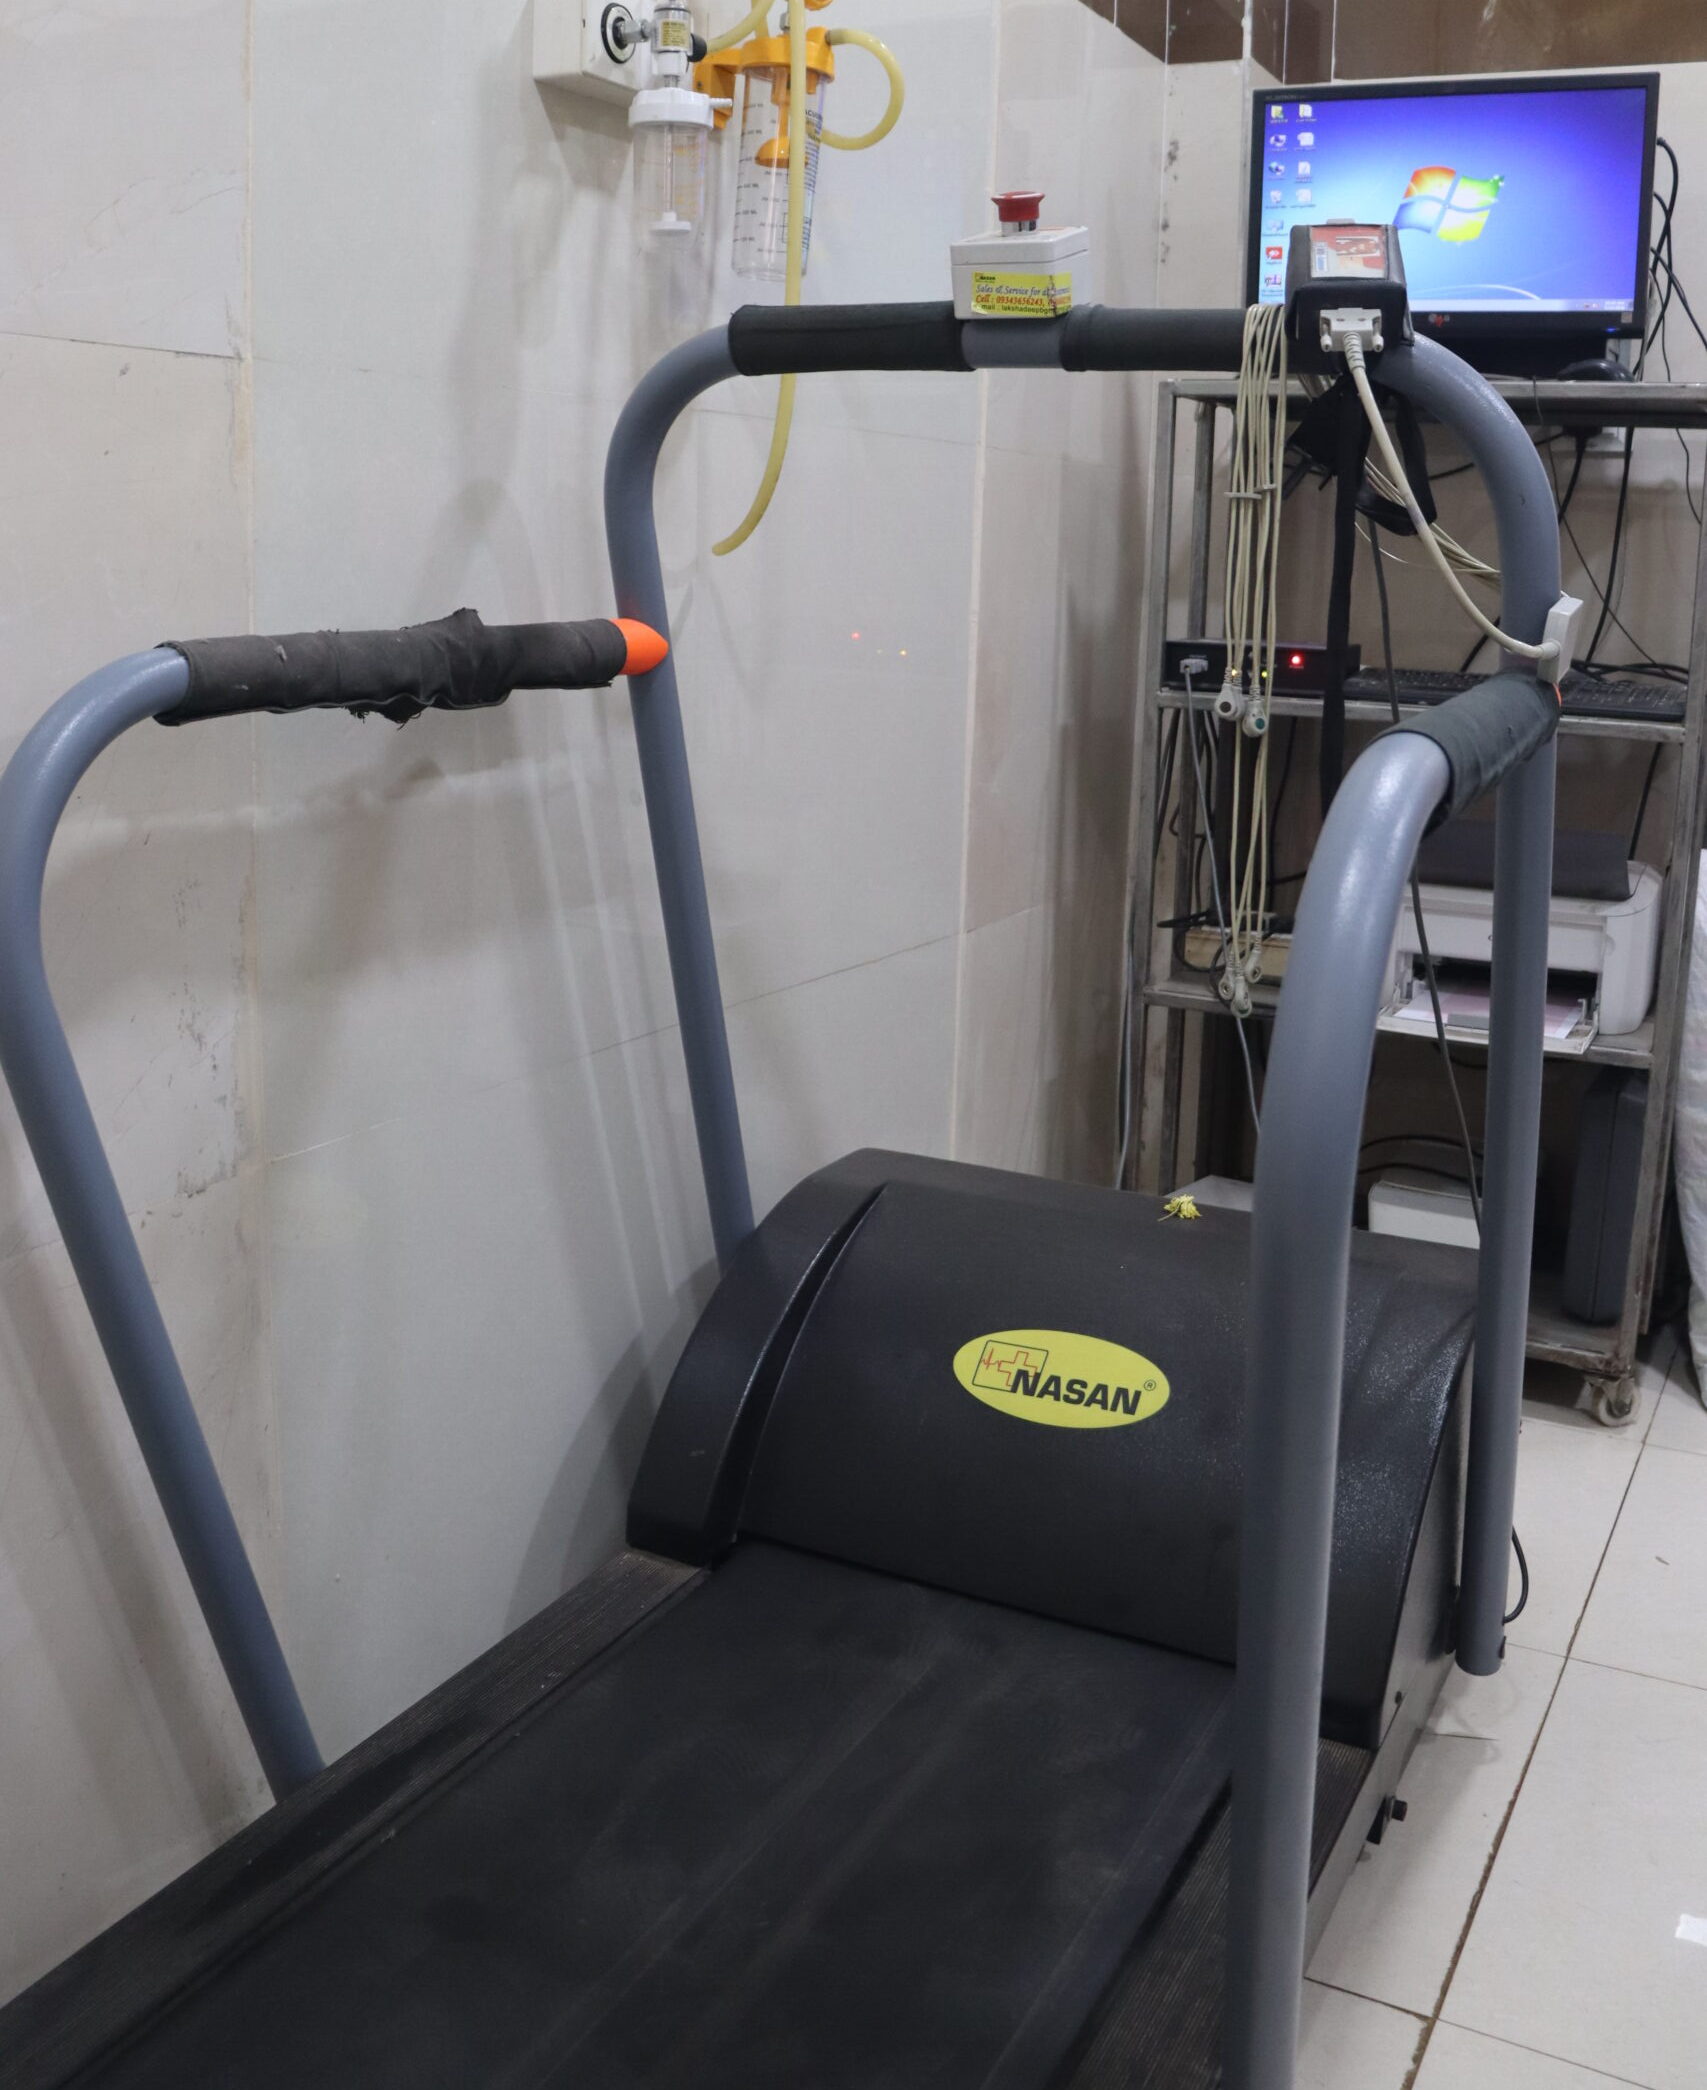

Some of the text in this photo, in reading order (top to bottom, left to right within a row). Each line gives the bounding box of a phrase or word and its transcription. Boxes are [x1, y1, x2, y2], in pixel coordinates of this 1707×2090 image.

[976, 285, 992, 294] Sales
[1002, 286, 1029, 295] Service
[1030, 287, 1041, 298] for
[1010, 1368, 1142, 1416] NASAN
